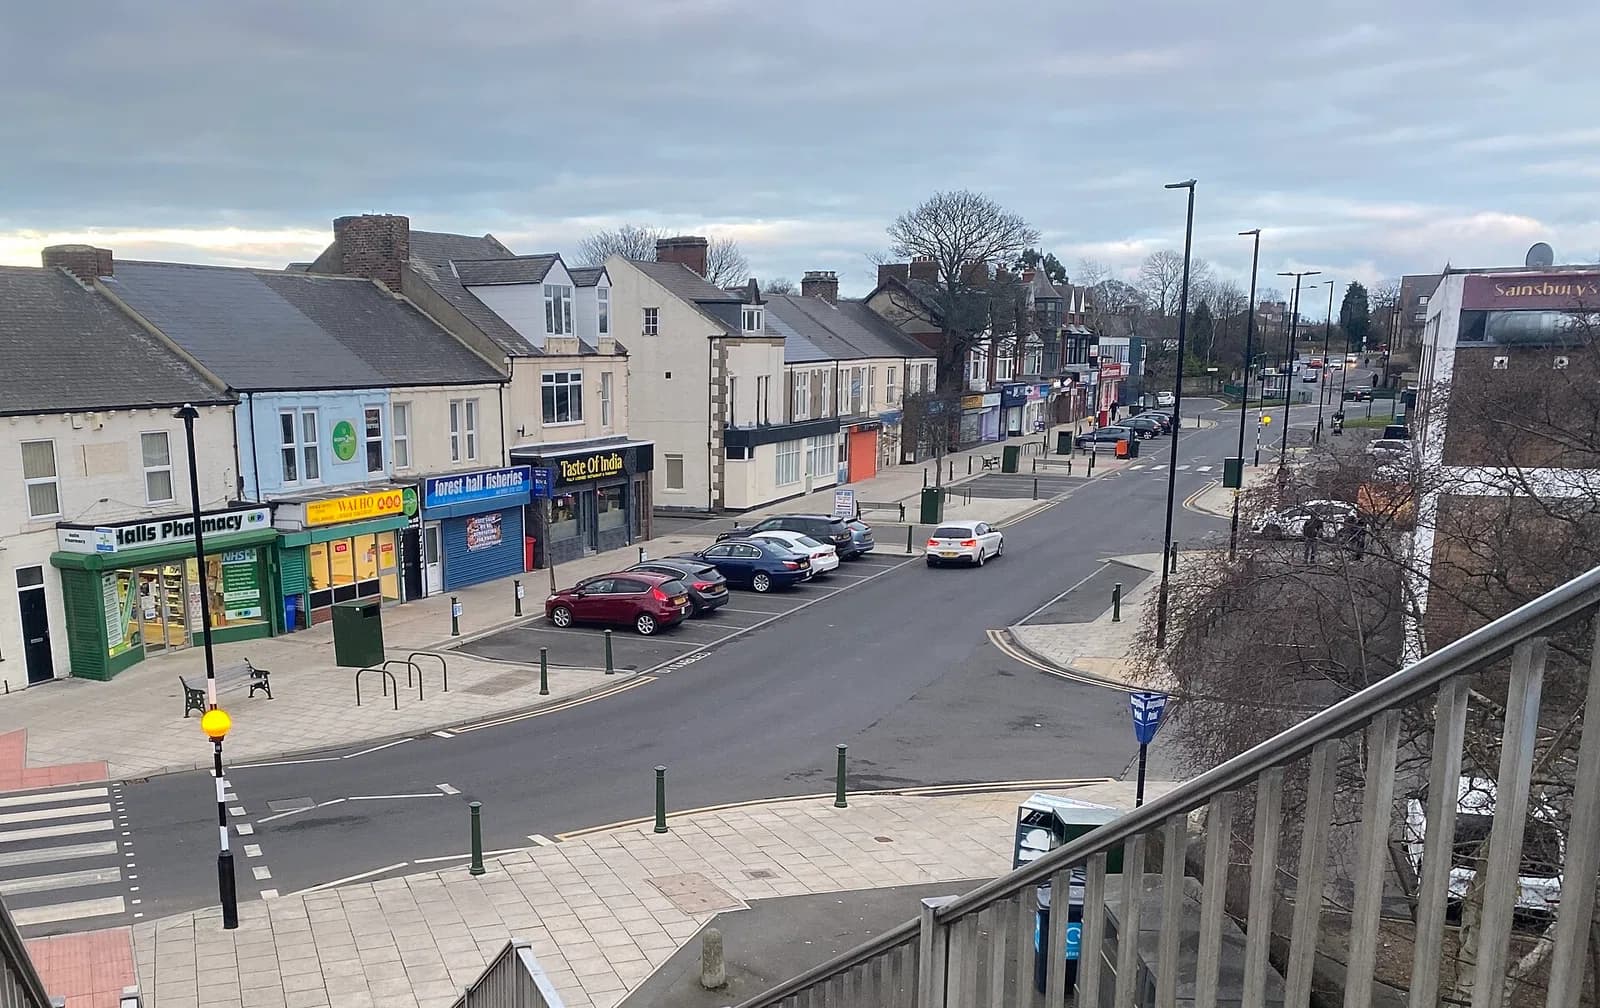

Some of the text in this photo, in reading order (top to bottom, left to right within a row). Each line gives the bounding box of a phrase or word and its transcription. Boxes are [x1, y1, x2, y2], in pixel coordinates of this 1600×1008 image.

[1495, 281, 1597, 297] Sainsbury's
[560, 459, 586, 478] Taste
[587, 454, 599, 473] Of
[600, 452, 623, 472] India
[435, 478, 463, 497] forest
[465, 474, 483, 493] hall
[486, 470, 523, 490] fisheries
[337, 498, 359, 513] WAI
[360, 496, 374, 510] HO
[162, 514, 243, 539] Phamacy
[222, 550, 246, 561] NHS
